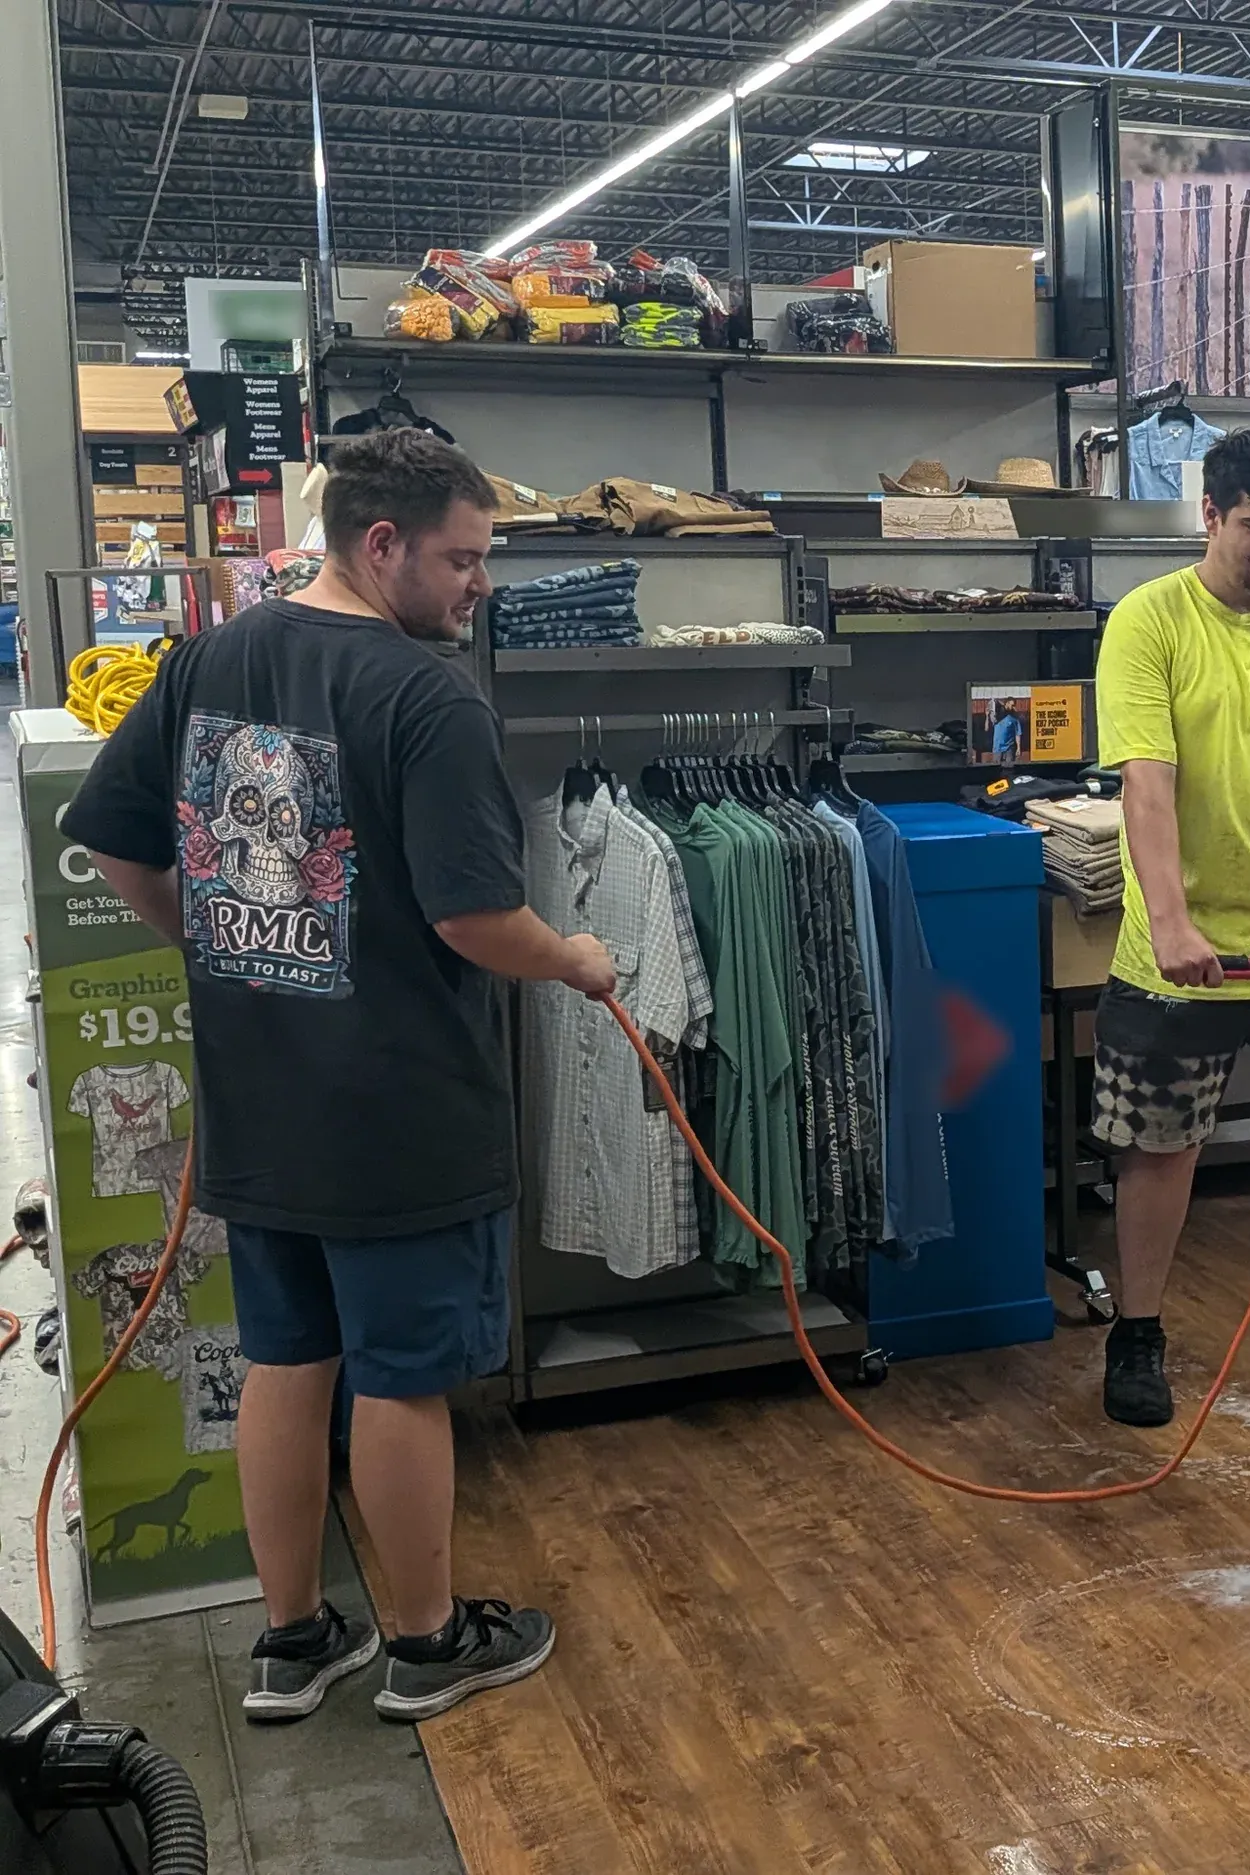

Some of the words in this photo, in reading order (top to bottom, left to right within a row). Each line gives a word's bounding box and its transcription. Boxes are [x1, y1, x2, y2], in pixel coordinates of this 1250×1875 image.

[246, 387, 278, 395] Apparel
[245, 400, 281, 408] Womens
[250, 431, 281, 439] Apparel
[168, 447, 177, 457] 2
[249, 453, 286, 461] Footwear
[702, 631, 750, 646] ELD
[1036, 710, 1047, 719] THE
[66, 898, 95, 910] Get
[68, 912, 118, 926] Before
[208, 897, 333, 962] RMC
[220, 958, 247, 973] BUILT
[254, 962, 275, 976] TO
[279, 966, 320, 985] LAST
[69, 973, 180, 1001] Graphic
[79, 1001, 194, 1049] $19.9
[114, 1256, 160, 1273] Coor
[194, 1342, 243, 1362] Coor
